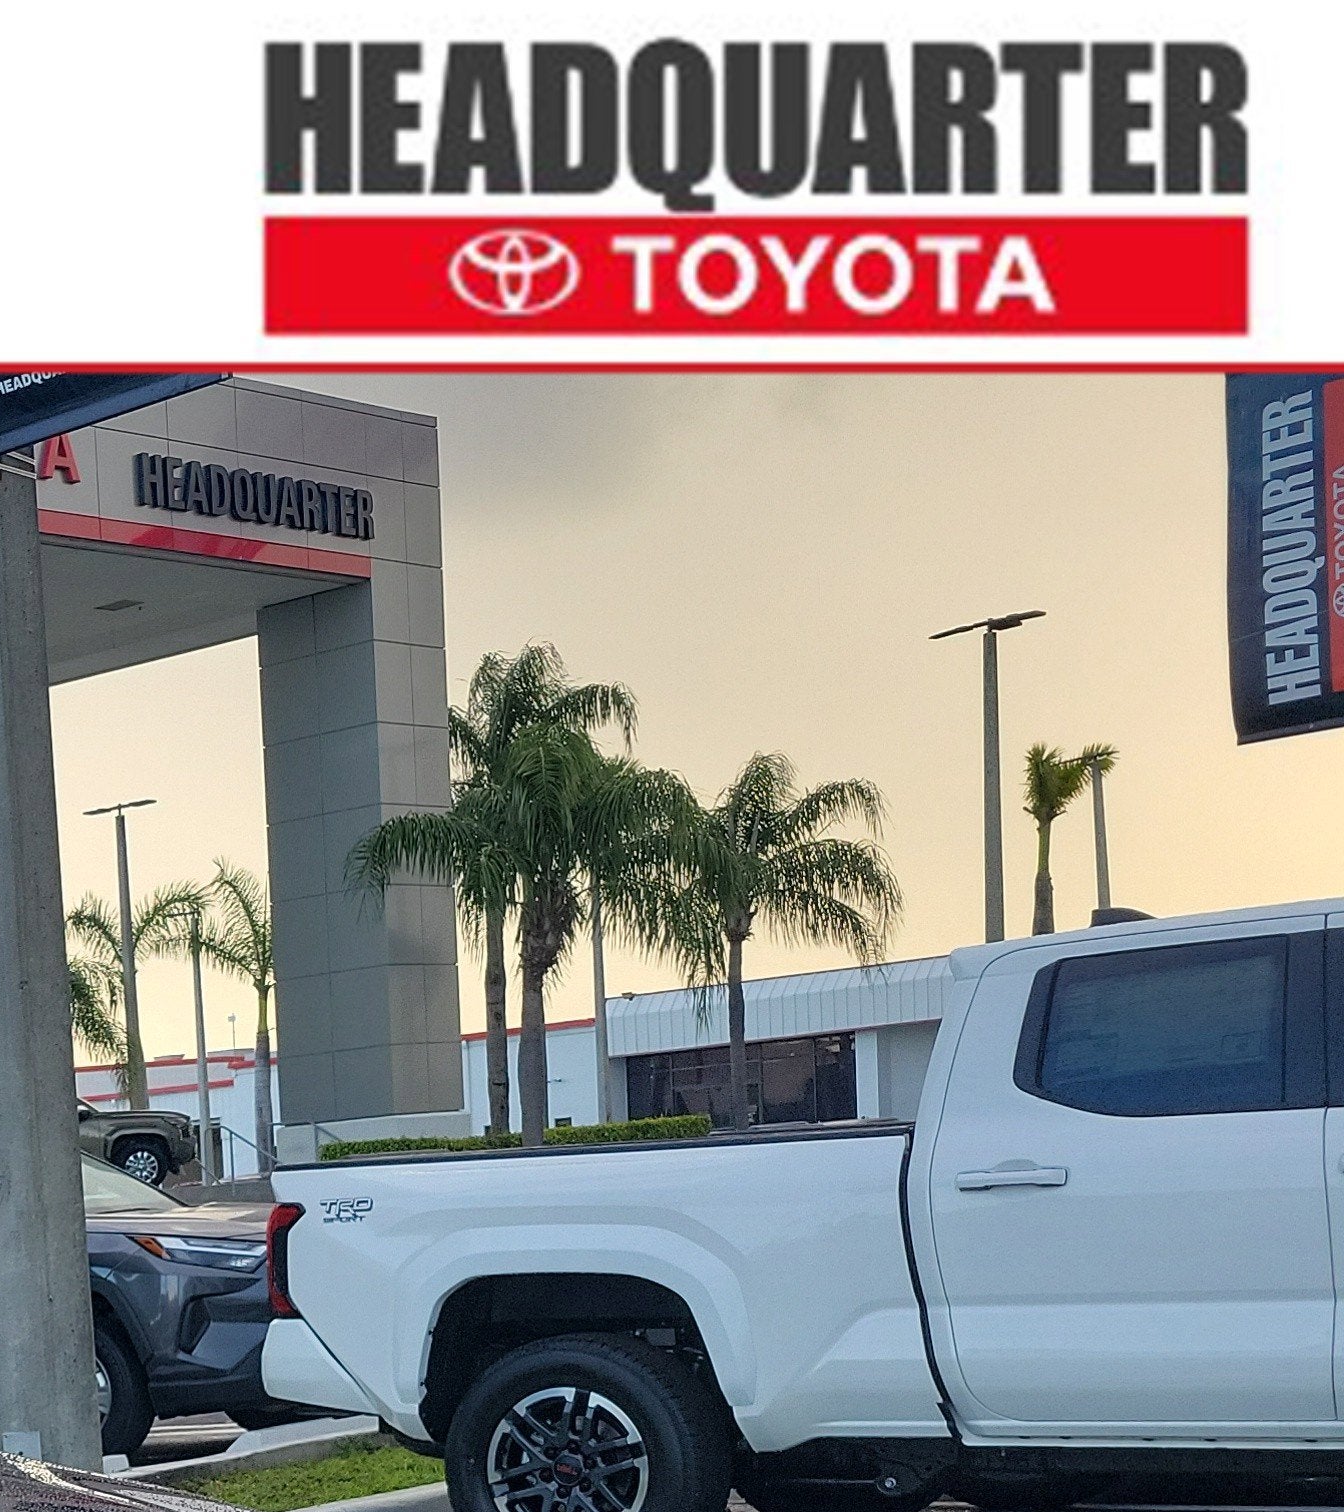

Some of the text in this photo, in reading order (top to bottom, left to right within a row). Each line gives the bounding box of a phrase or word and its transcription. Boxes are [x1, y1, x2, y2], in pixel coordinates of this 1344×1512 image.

[134, 453, 374, 540] HEADQUARTER
[1262, 389, 1325, 705] HEADQUARTER
[320, 1197, 373, 1217] TRD
